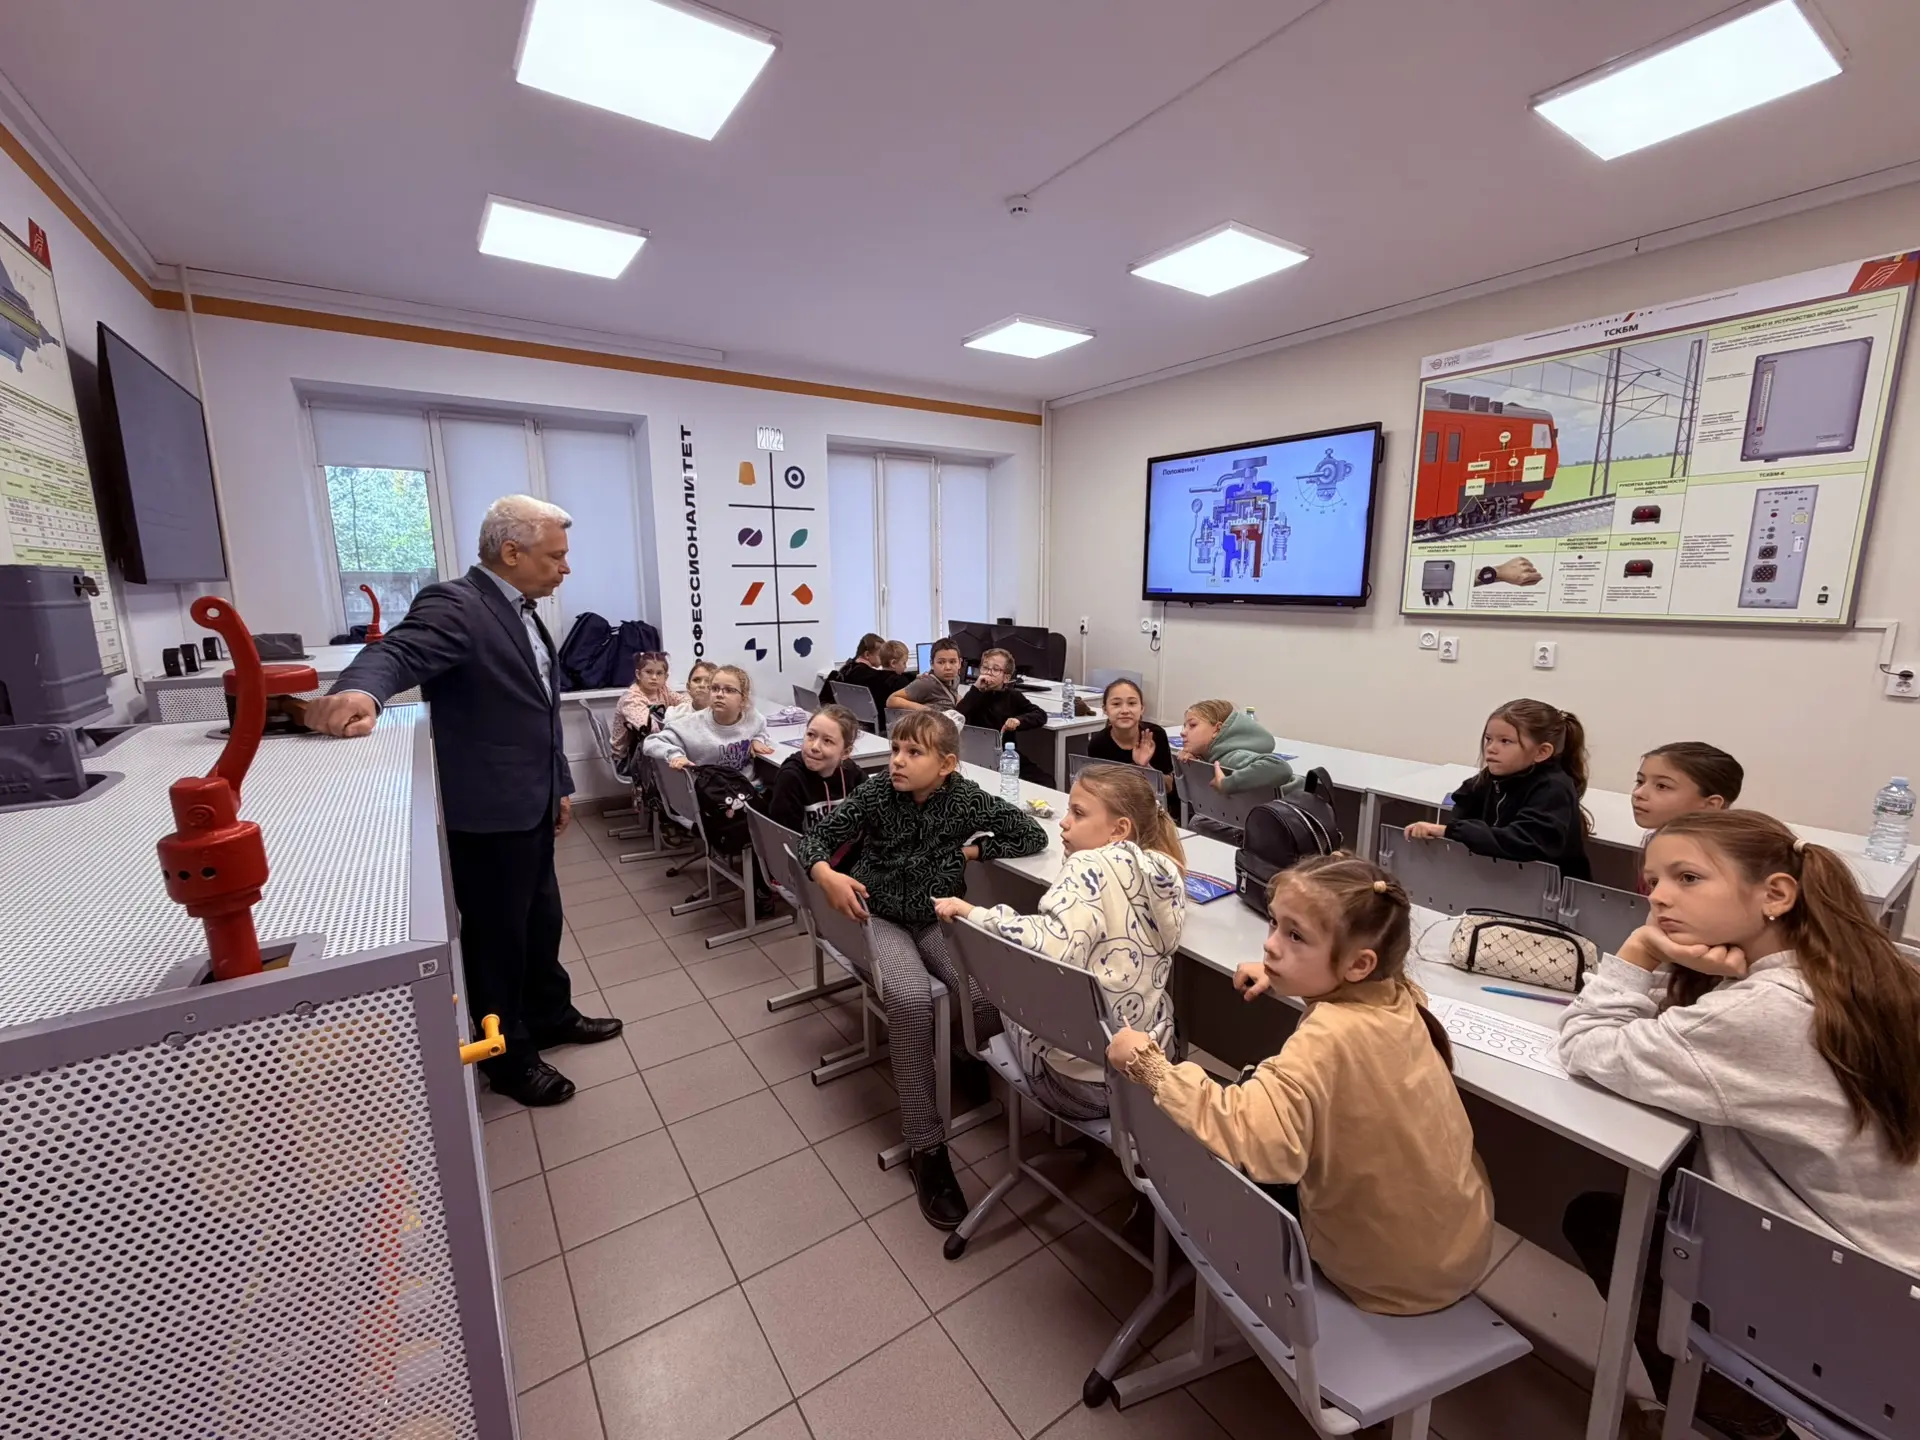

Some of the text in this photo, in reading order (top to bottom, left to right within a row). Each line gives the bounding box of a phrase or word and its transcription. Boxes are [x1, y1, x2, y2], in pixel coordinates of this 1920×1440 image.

[1604, 324, 1639, 337] ТСКБМ
[759, 426, 782, 449] 2022
[1162, 466, 1196, 476] Положение
[680, 425, 706, 662] ОФЕССИОНАЛИТЕТ
